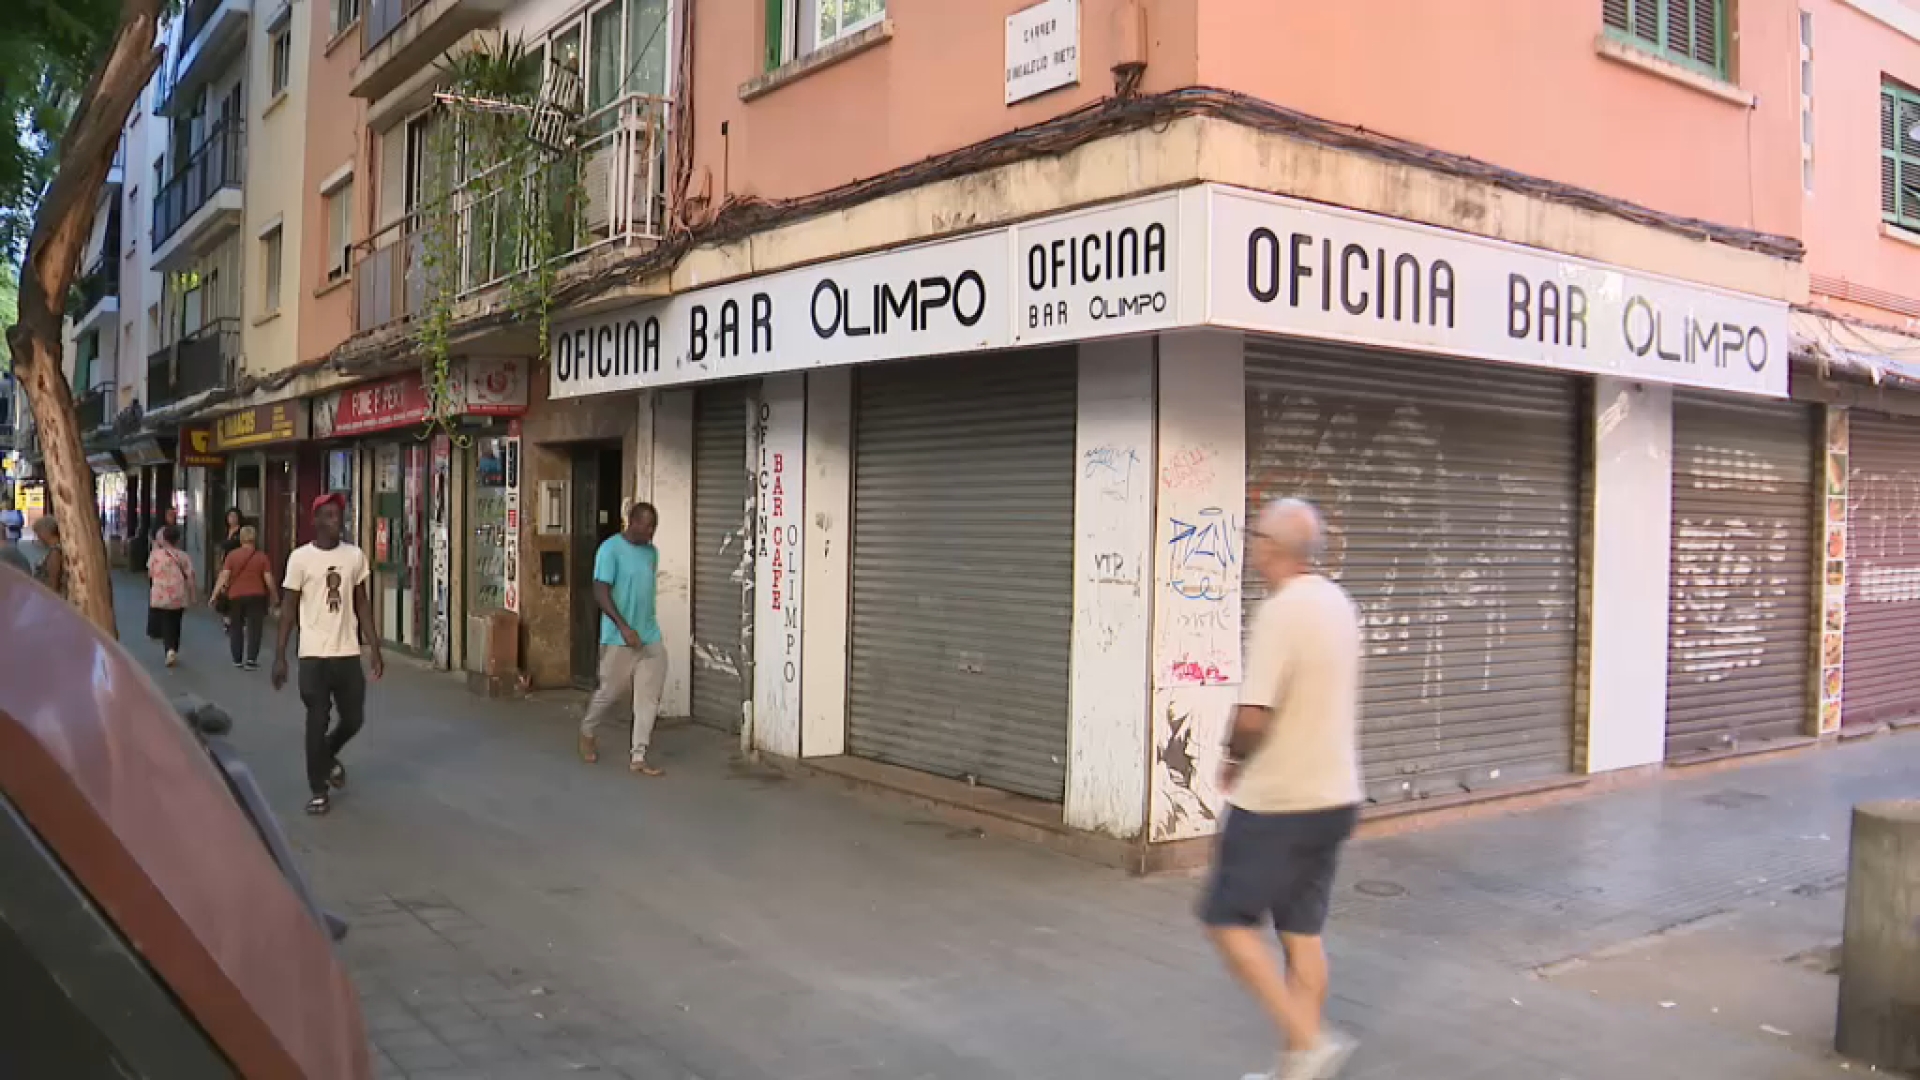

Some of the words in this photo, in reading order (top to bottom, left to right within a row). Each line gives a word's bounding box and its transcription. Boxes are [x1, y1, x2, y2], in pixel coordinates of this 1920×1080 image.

[1028, 222, 1165, 291] OFICINA
[1029, 301, 1068, 329] BAR
[1089, 291, 1167, 320] OLIMPO
[1247, 226, 1455, 329] OFICINA
[1507, 272, 1588, 348] BAR
[1623, 295, 1769, 373] OLIMPO
[557, 315, 660, 382] OFICINA
[690, 292, 773, 362] BAR
[811, 269, 986, 339] OLIMPO
[758, 402, 770, 558] OFICINA
[772, 453, 783, 517] BAR
[783, 524, 798, 683] OLIMPO
